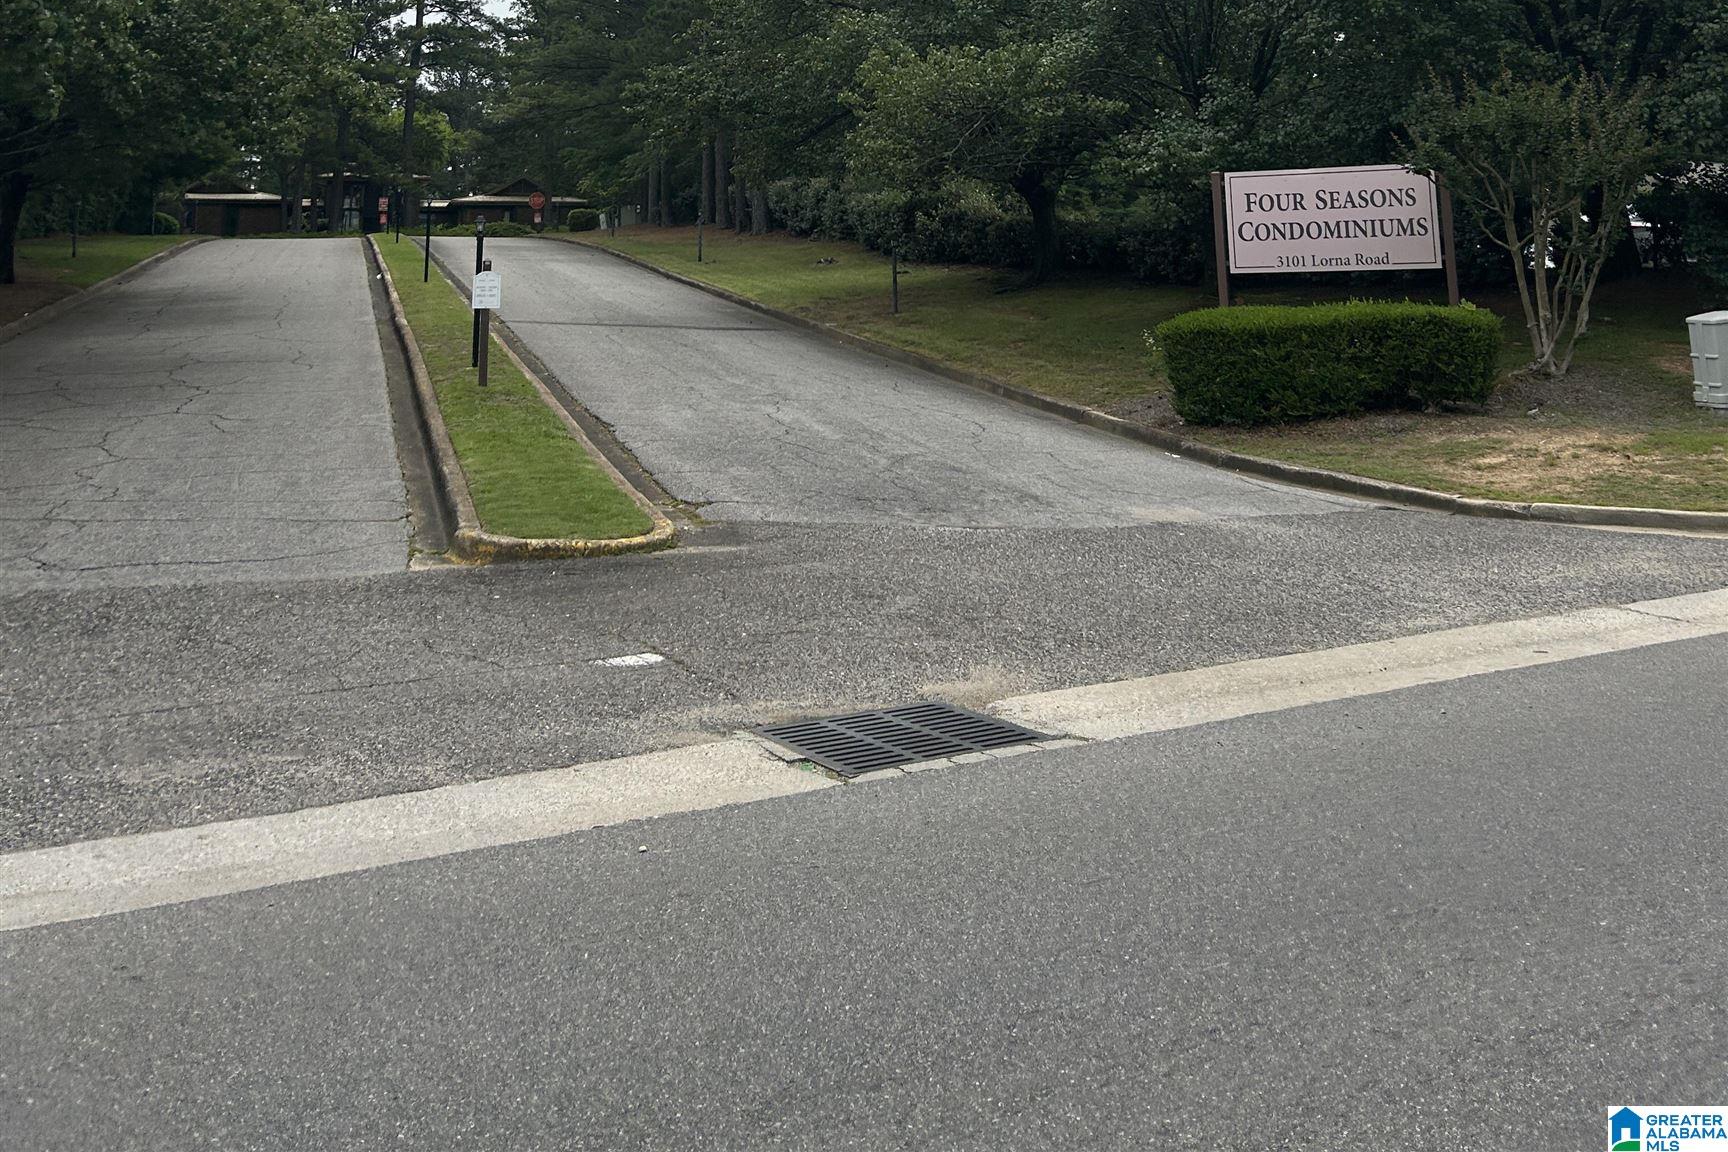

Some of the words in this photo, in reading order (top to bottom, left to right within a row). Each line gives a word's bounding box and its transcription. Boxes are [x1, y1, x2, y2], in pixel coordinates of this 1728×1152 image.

[1244, 192, 1307, 213] FOUR
[1315, 187, 1417, 211] SEASONS
[1237, 216, 1429, 242] CONDOMINIUMS
[1276, 255, 1306, 268] 3101
[1311, 254, 1350, 267] Lorna
[1355, 252, 1390, 266] Road
